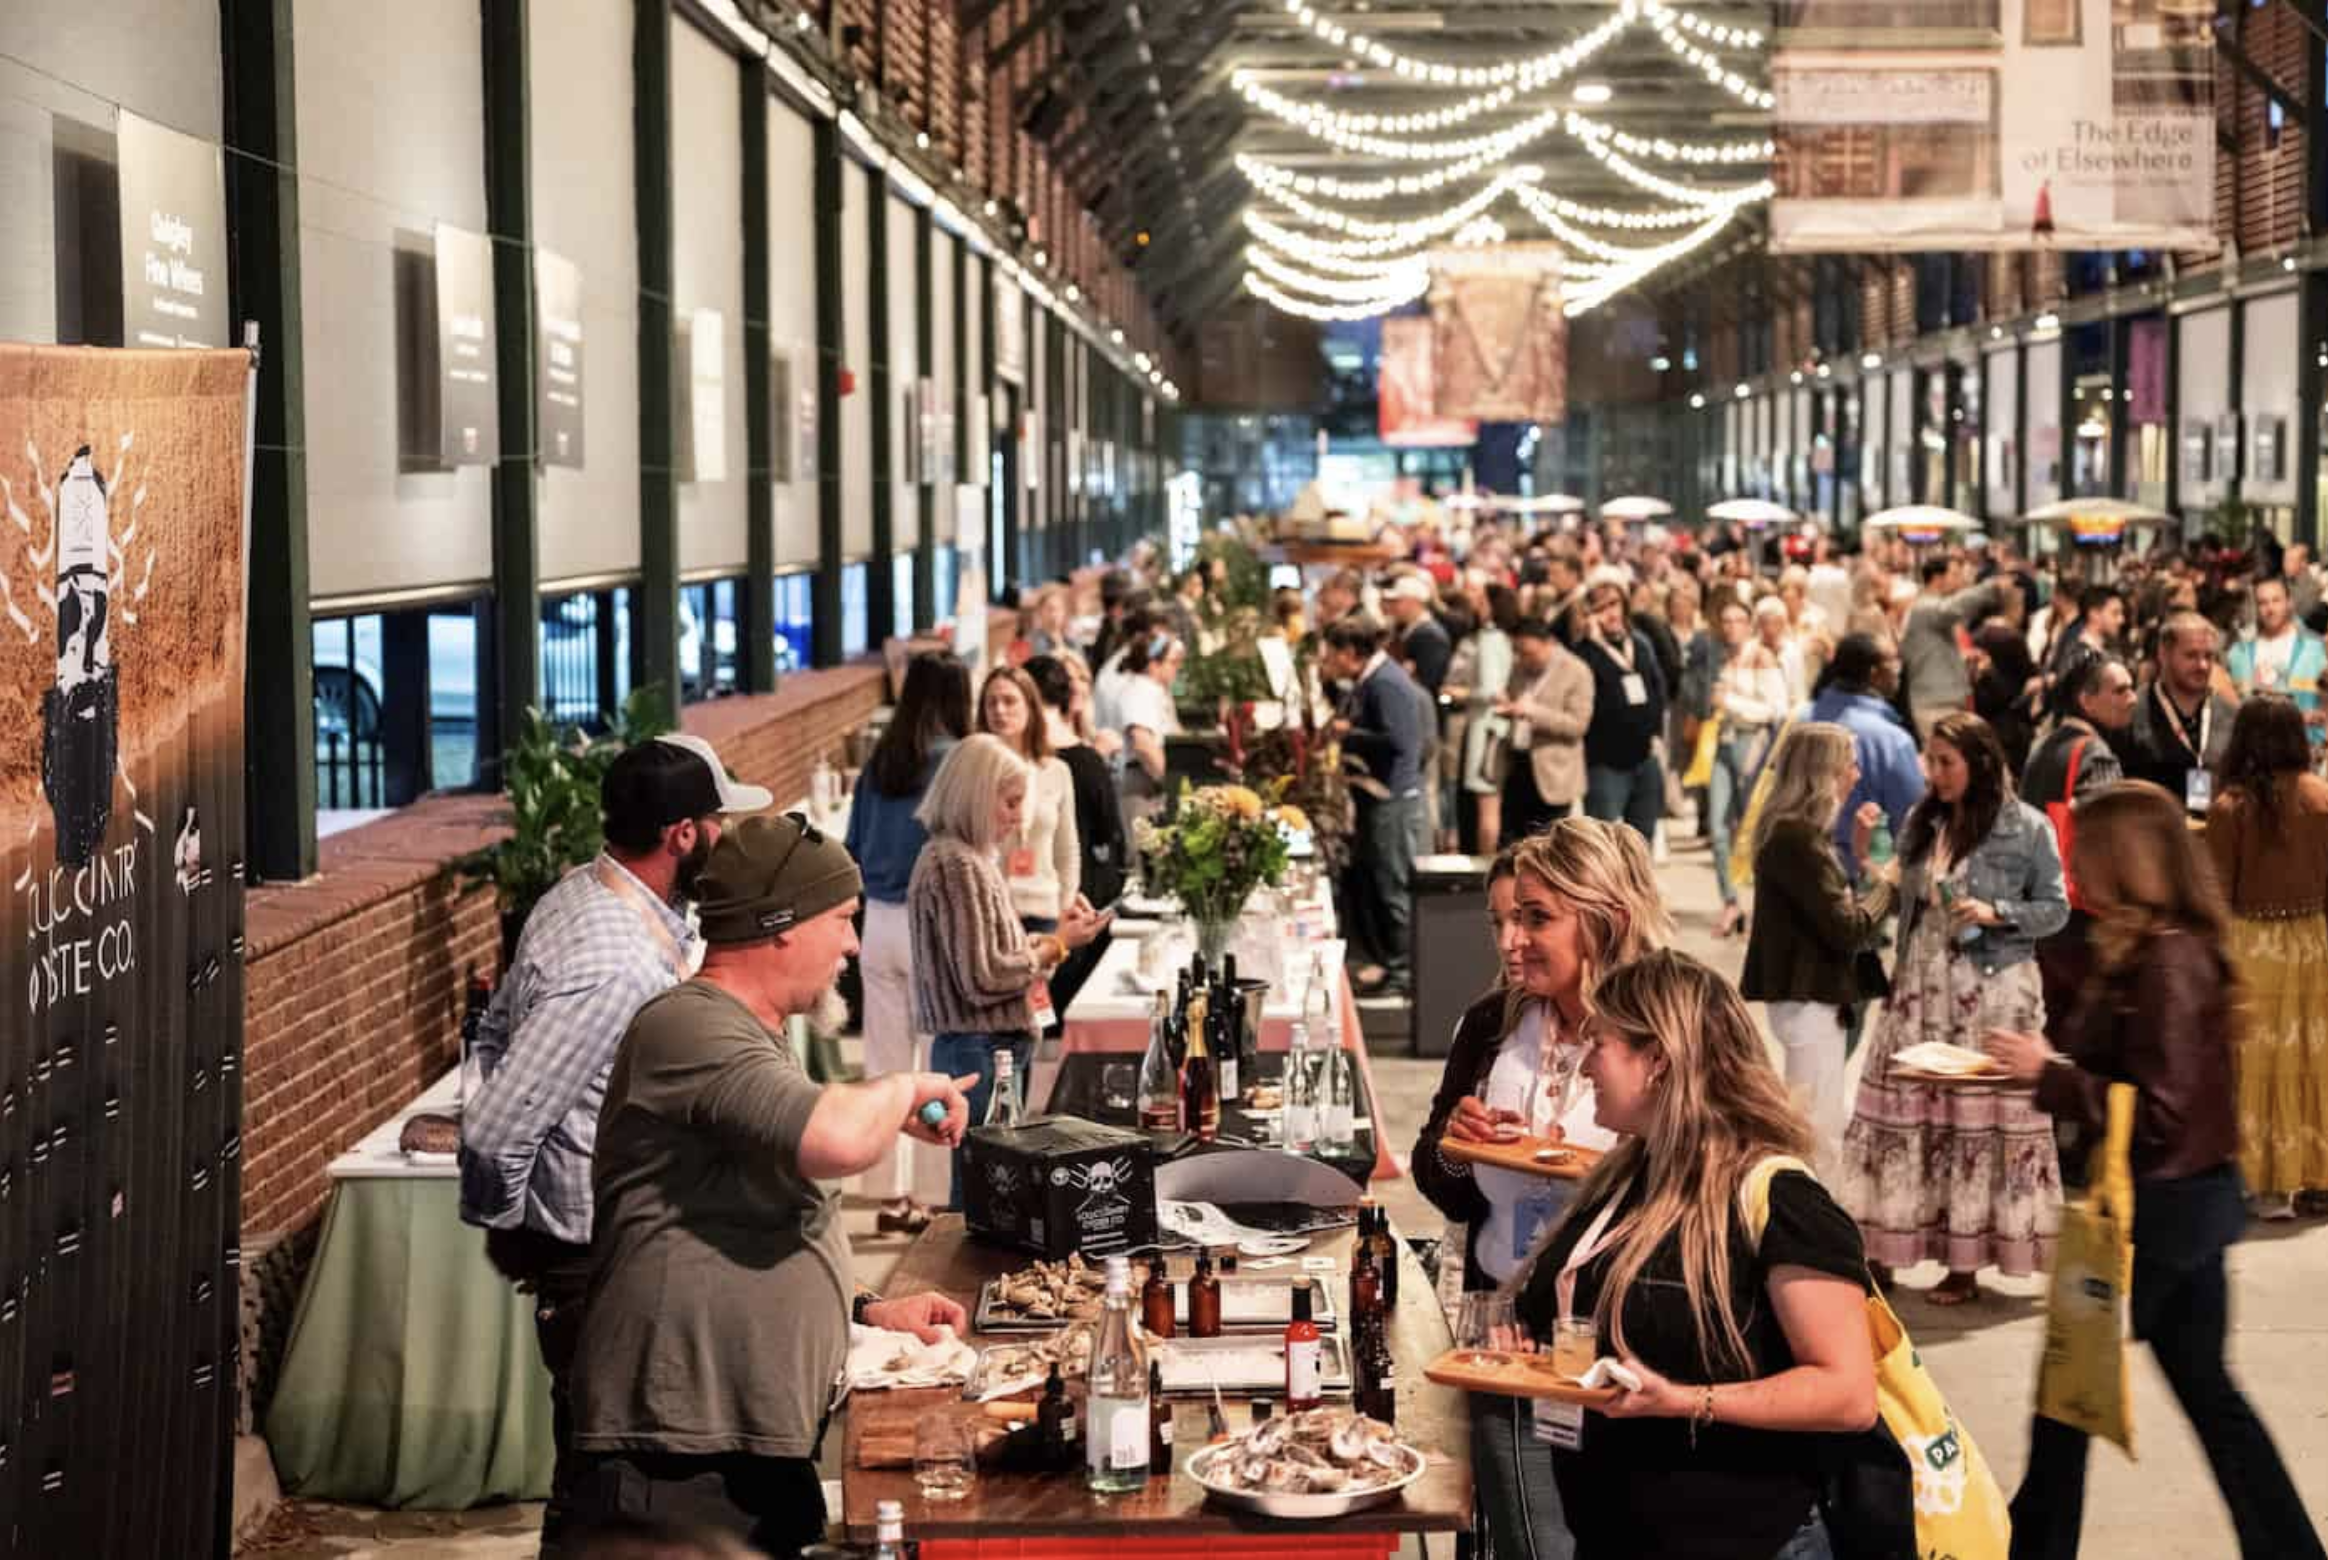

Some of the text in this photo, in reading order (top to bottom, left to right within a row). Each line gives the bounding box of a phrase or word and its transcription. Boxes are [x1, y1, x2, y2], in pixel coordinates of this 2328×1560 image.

[2071, 120, 2193, 148] The Edge
[2021, 148, 2193, 172] of Elsewhere
